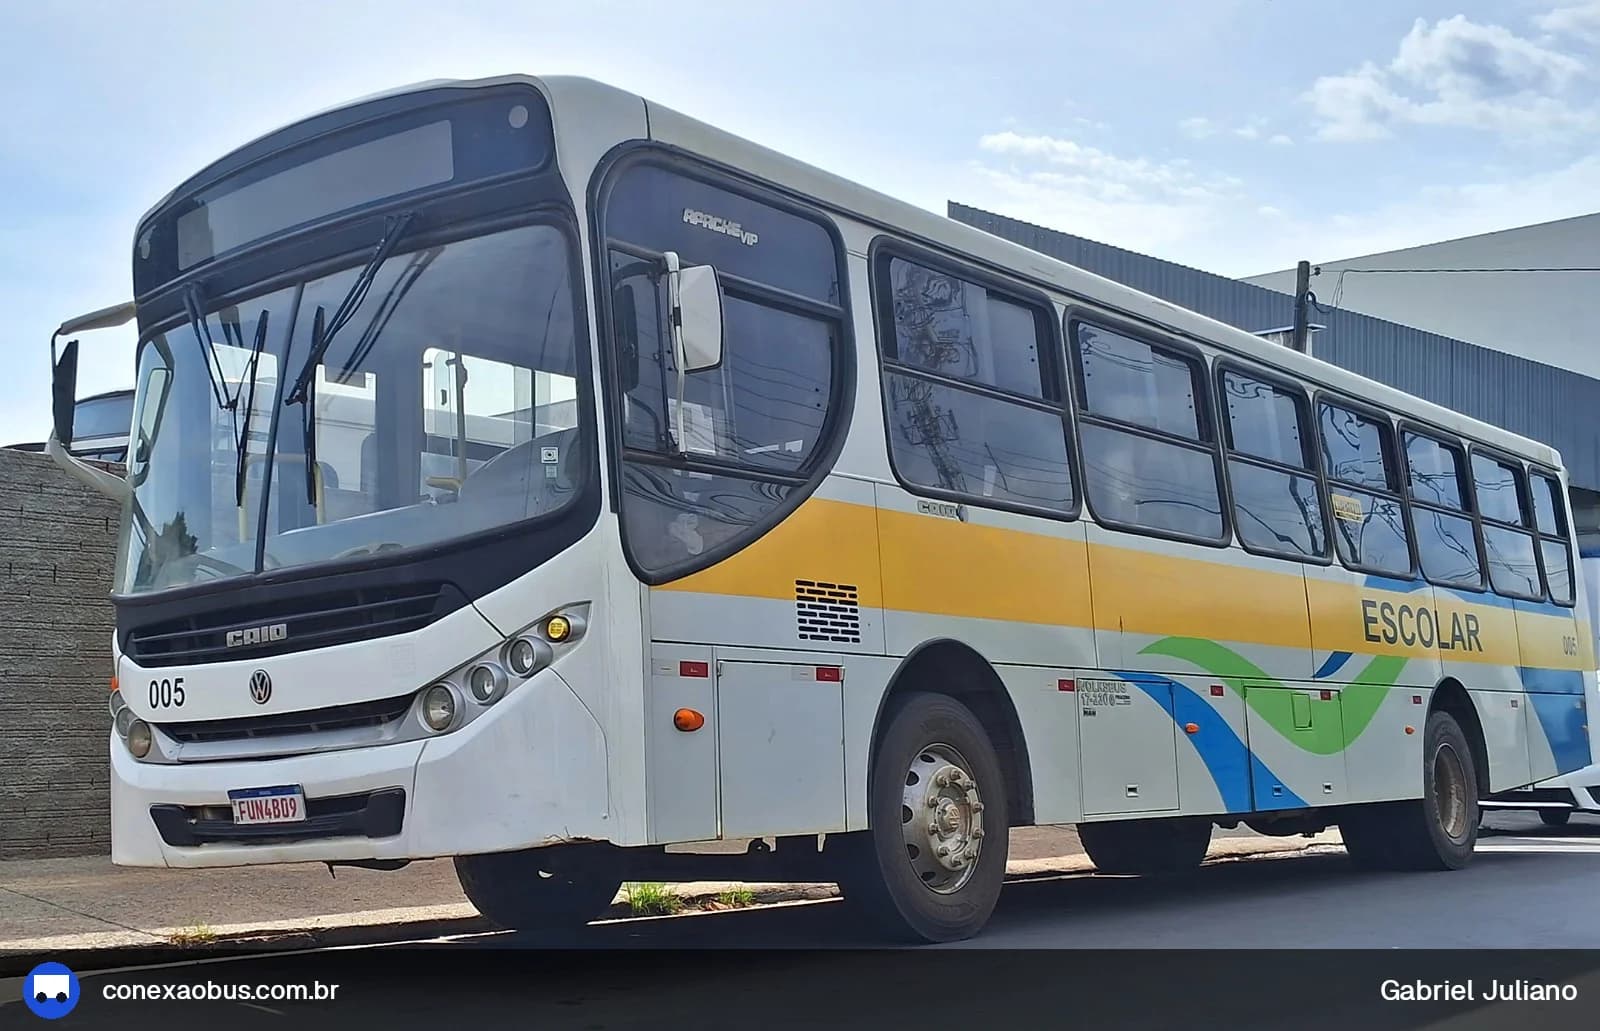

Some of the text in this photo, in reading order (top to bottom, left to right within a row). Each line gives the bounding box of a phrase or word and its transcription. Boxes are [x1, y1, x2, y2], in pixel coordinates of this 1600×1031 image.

[683, 207, 758, 246] APACHE VIP
[226, 623, 287, 648] CAIO
[1362, 599, 1483, 652] ESCOLAR
[149, 677, 185, 709] 005
[239, 797, 297, 820] FUN4B09
